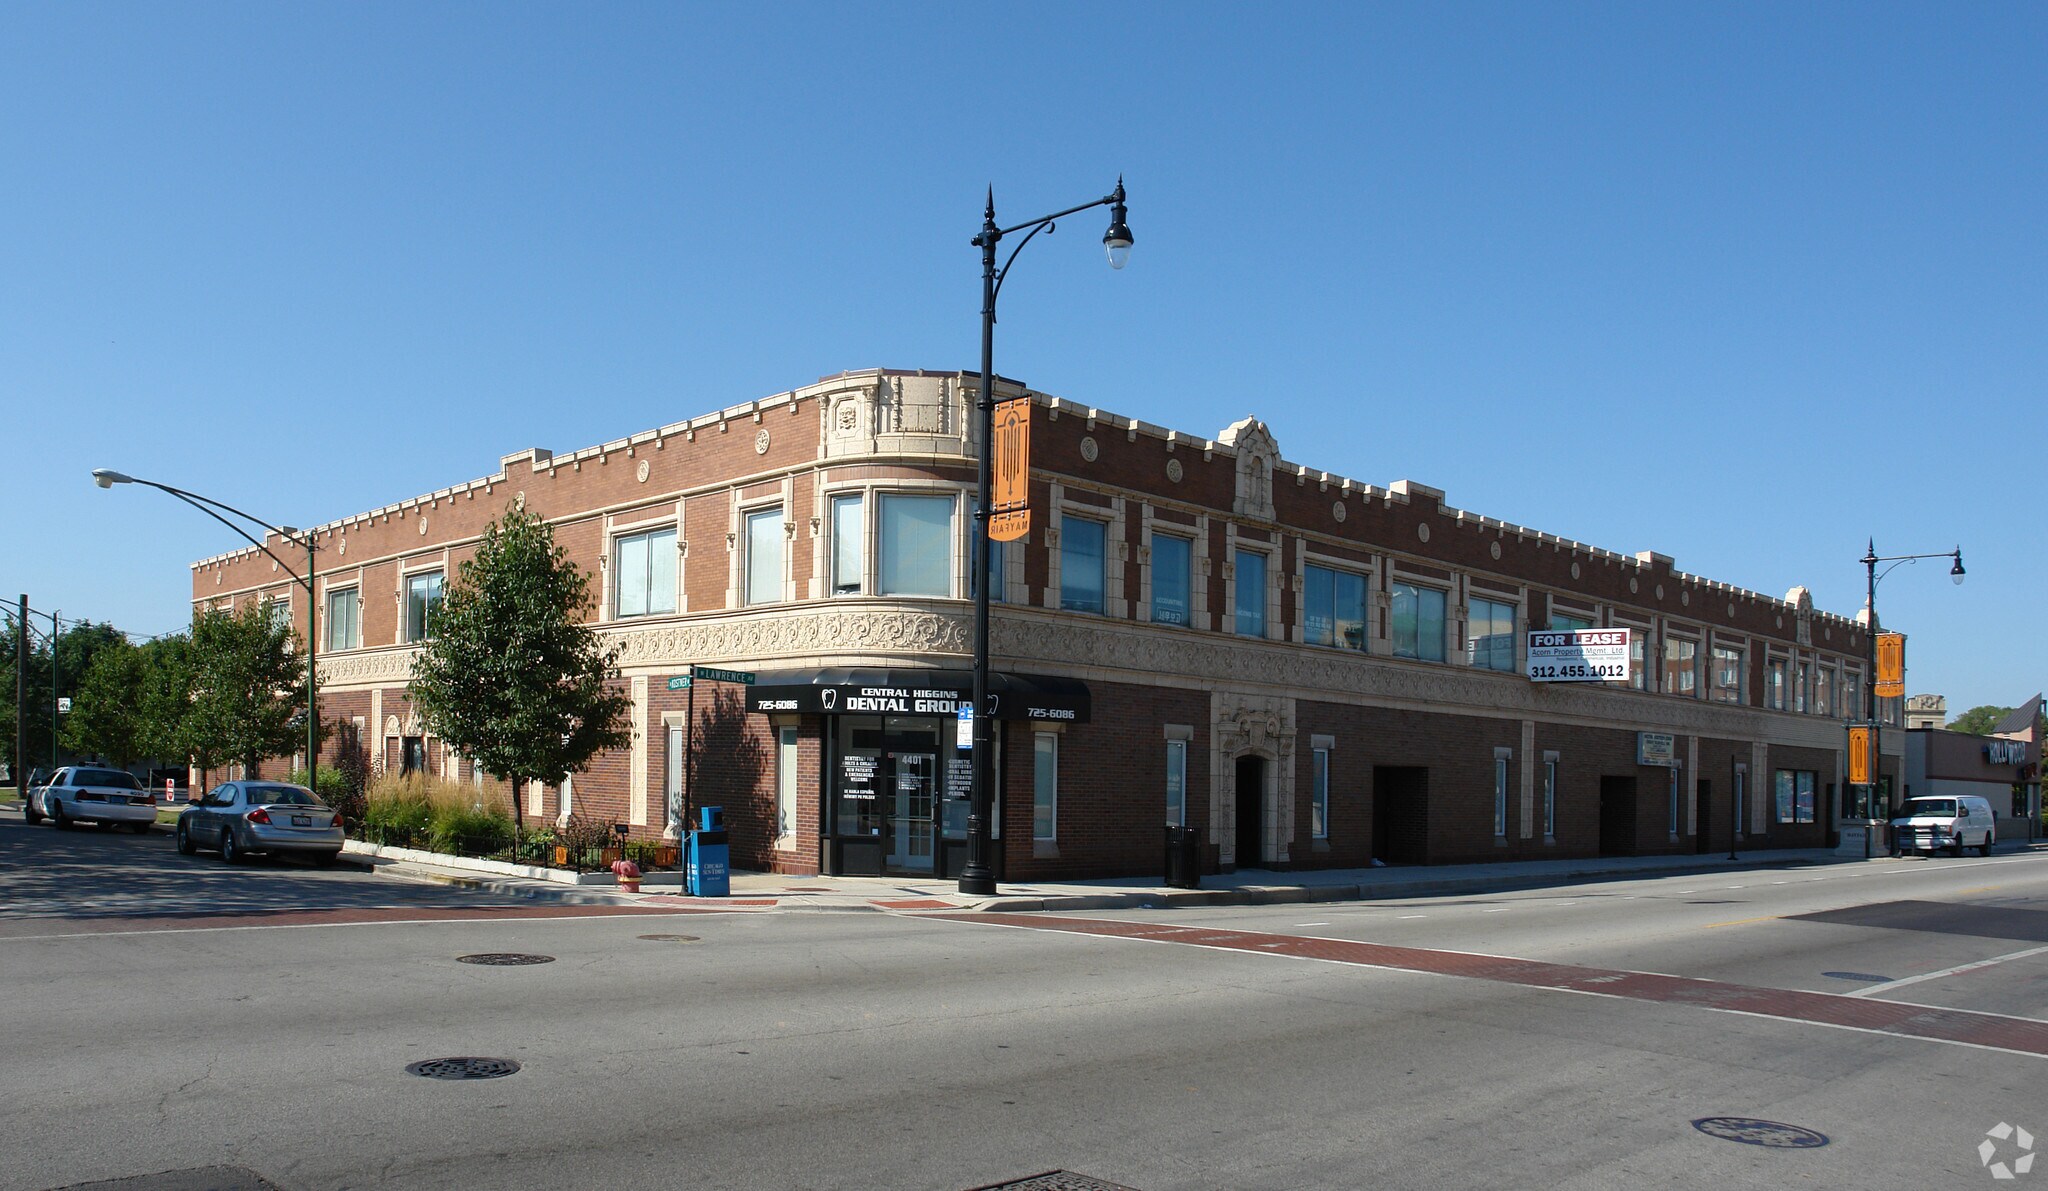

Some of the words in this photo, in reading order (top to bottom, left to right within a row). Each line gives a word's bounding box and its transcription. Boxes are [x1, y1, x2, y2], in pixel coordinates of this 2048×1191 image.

[1535, 635, 1565, 646] FOR
[1572, 634, 1621, 644] LEASE
[1554, 648, 1581, 656] Property
[705, 669, 746, 682] LAWRENCE
[1531, 665, 1624, 677] 312.455.1012
[861, 688, 909, 697] CENTRAL
[913, 689, 958, 698] HIGGINS
[758, 700, 798, 709] 725-6086
[847, 697, 908, 711] DENTAL
[1027, 707, 1074, 719] 725-6086
[902, 755, 921, 764] 4401
